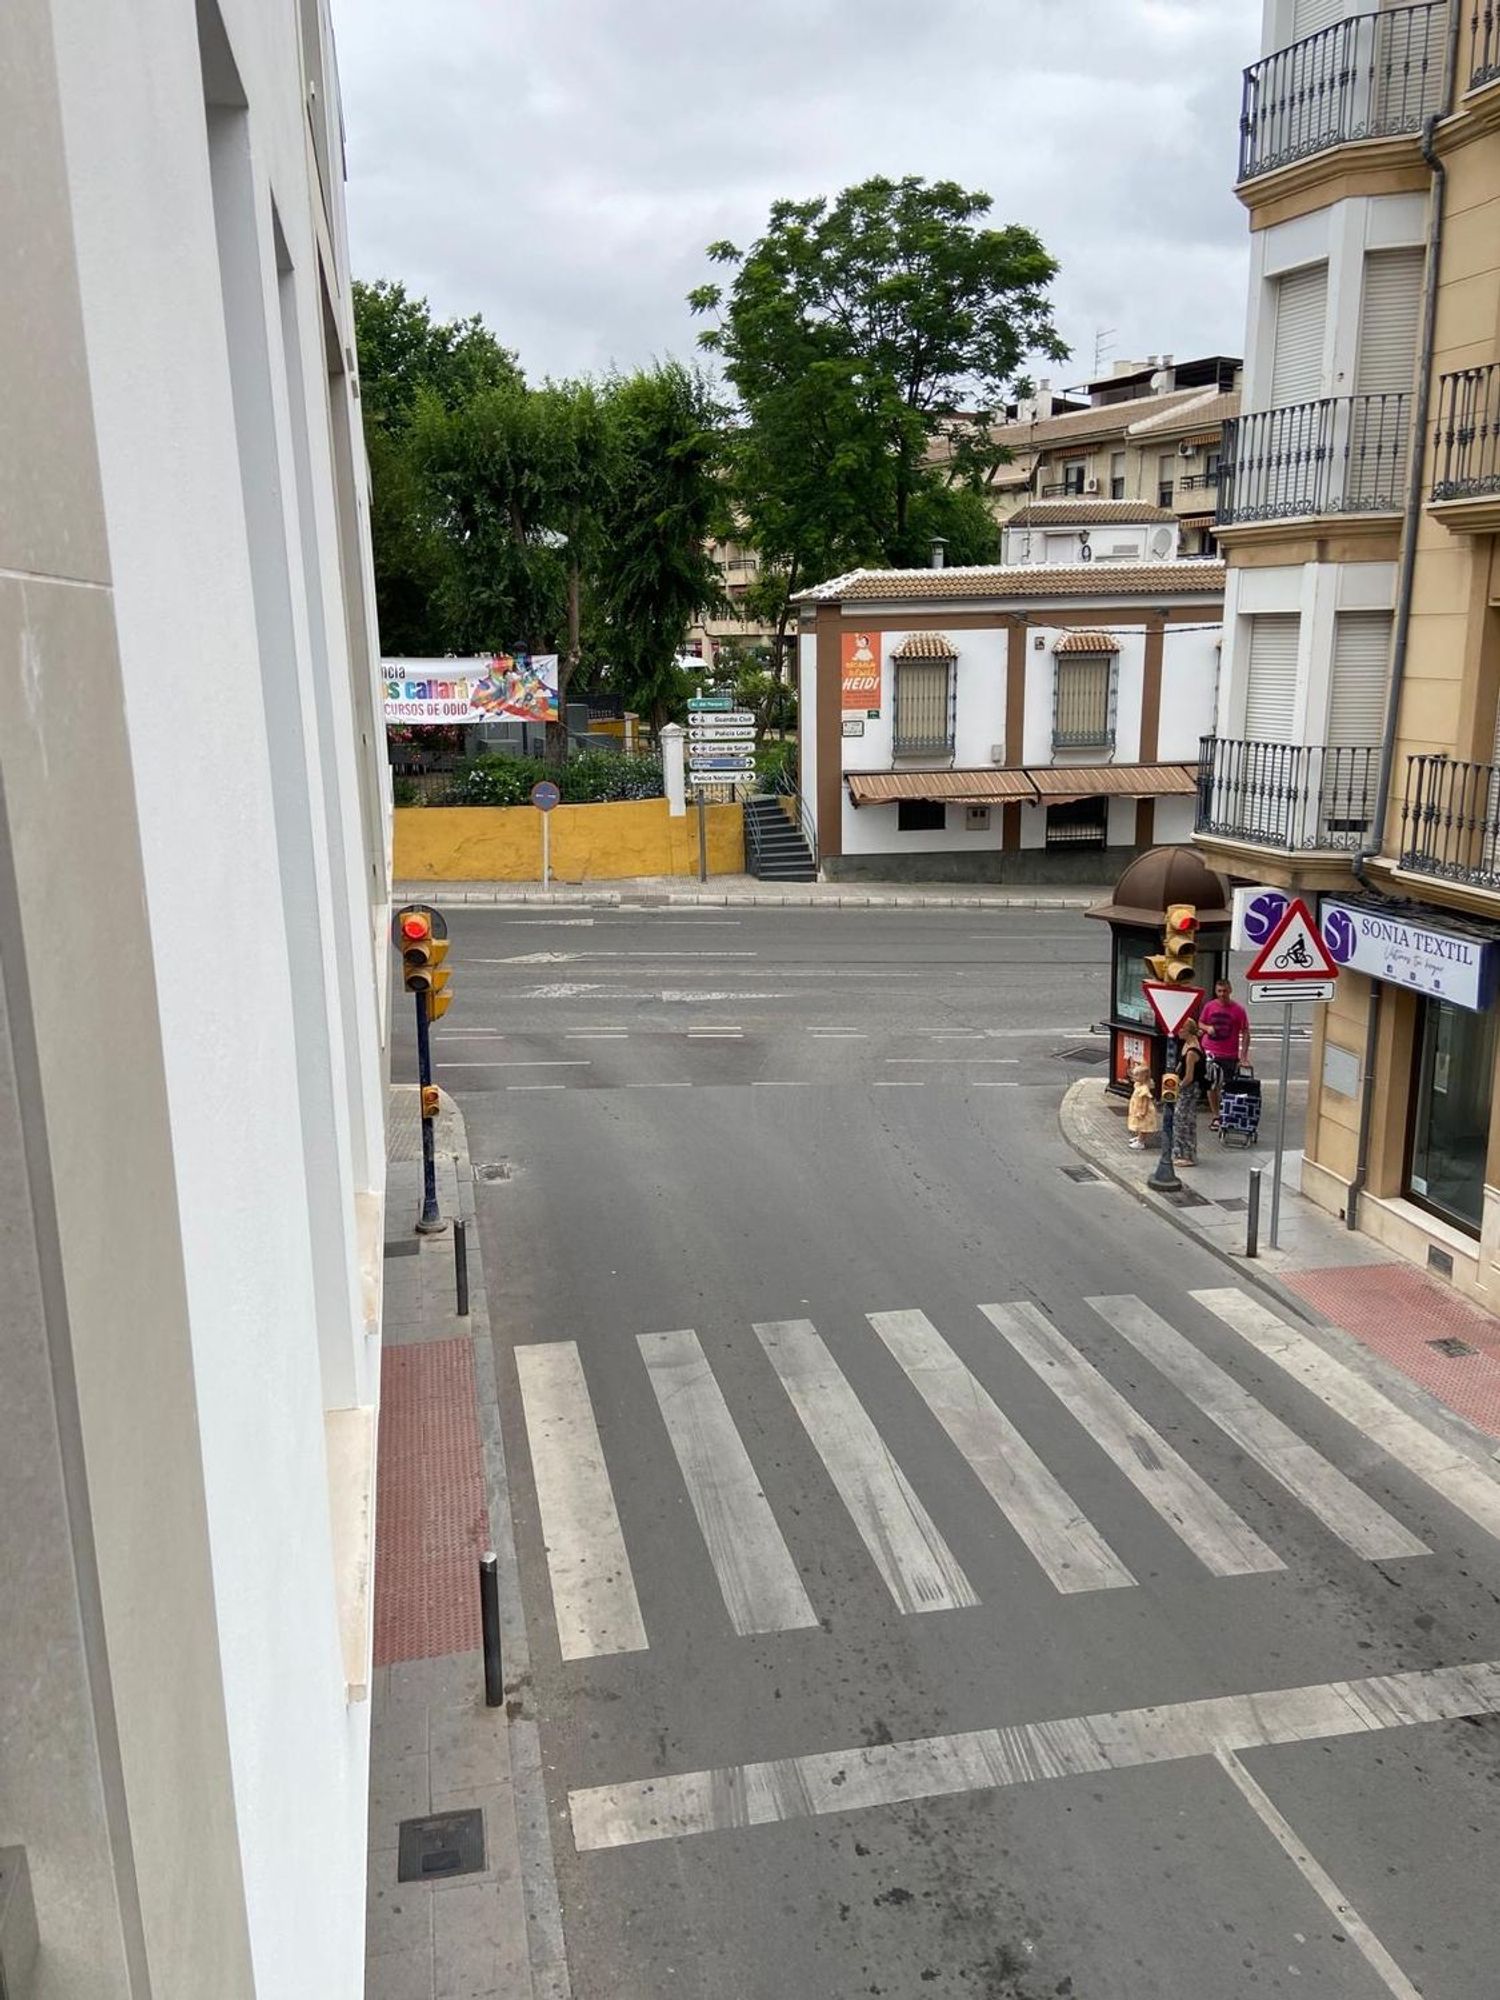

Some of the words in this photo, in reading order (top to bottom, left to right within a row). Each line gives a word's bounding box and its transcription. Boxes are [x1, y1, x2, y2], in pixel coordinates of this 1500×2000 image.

[842, 676, 880, 691] HEIDI
[427, 703, 440, 716] DE
[443, 703, 468, 716] ODIO
[1361, 918, 1409, 948] SONIA
[1413, 931, 1473, 965] TEXTIL
